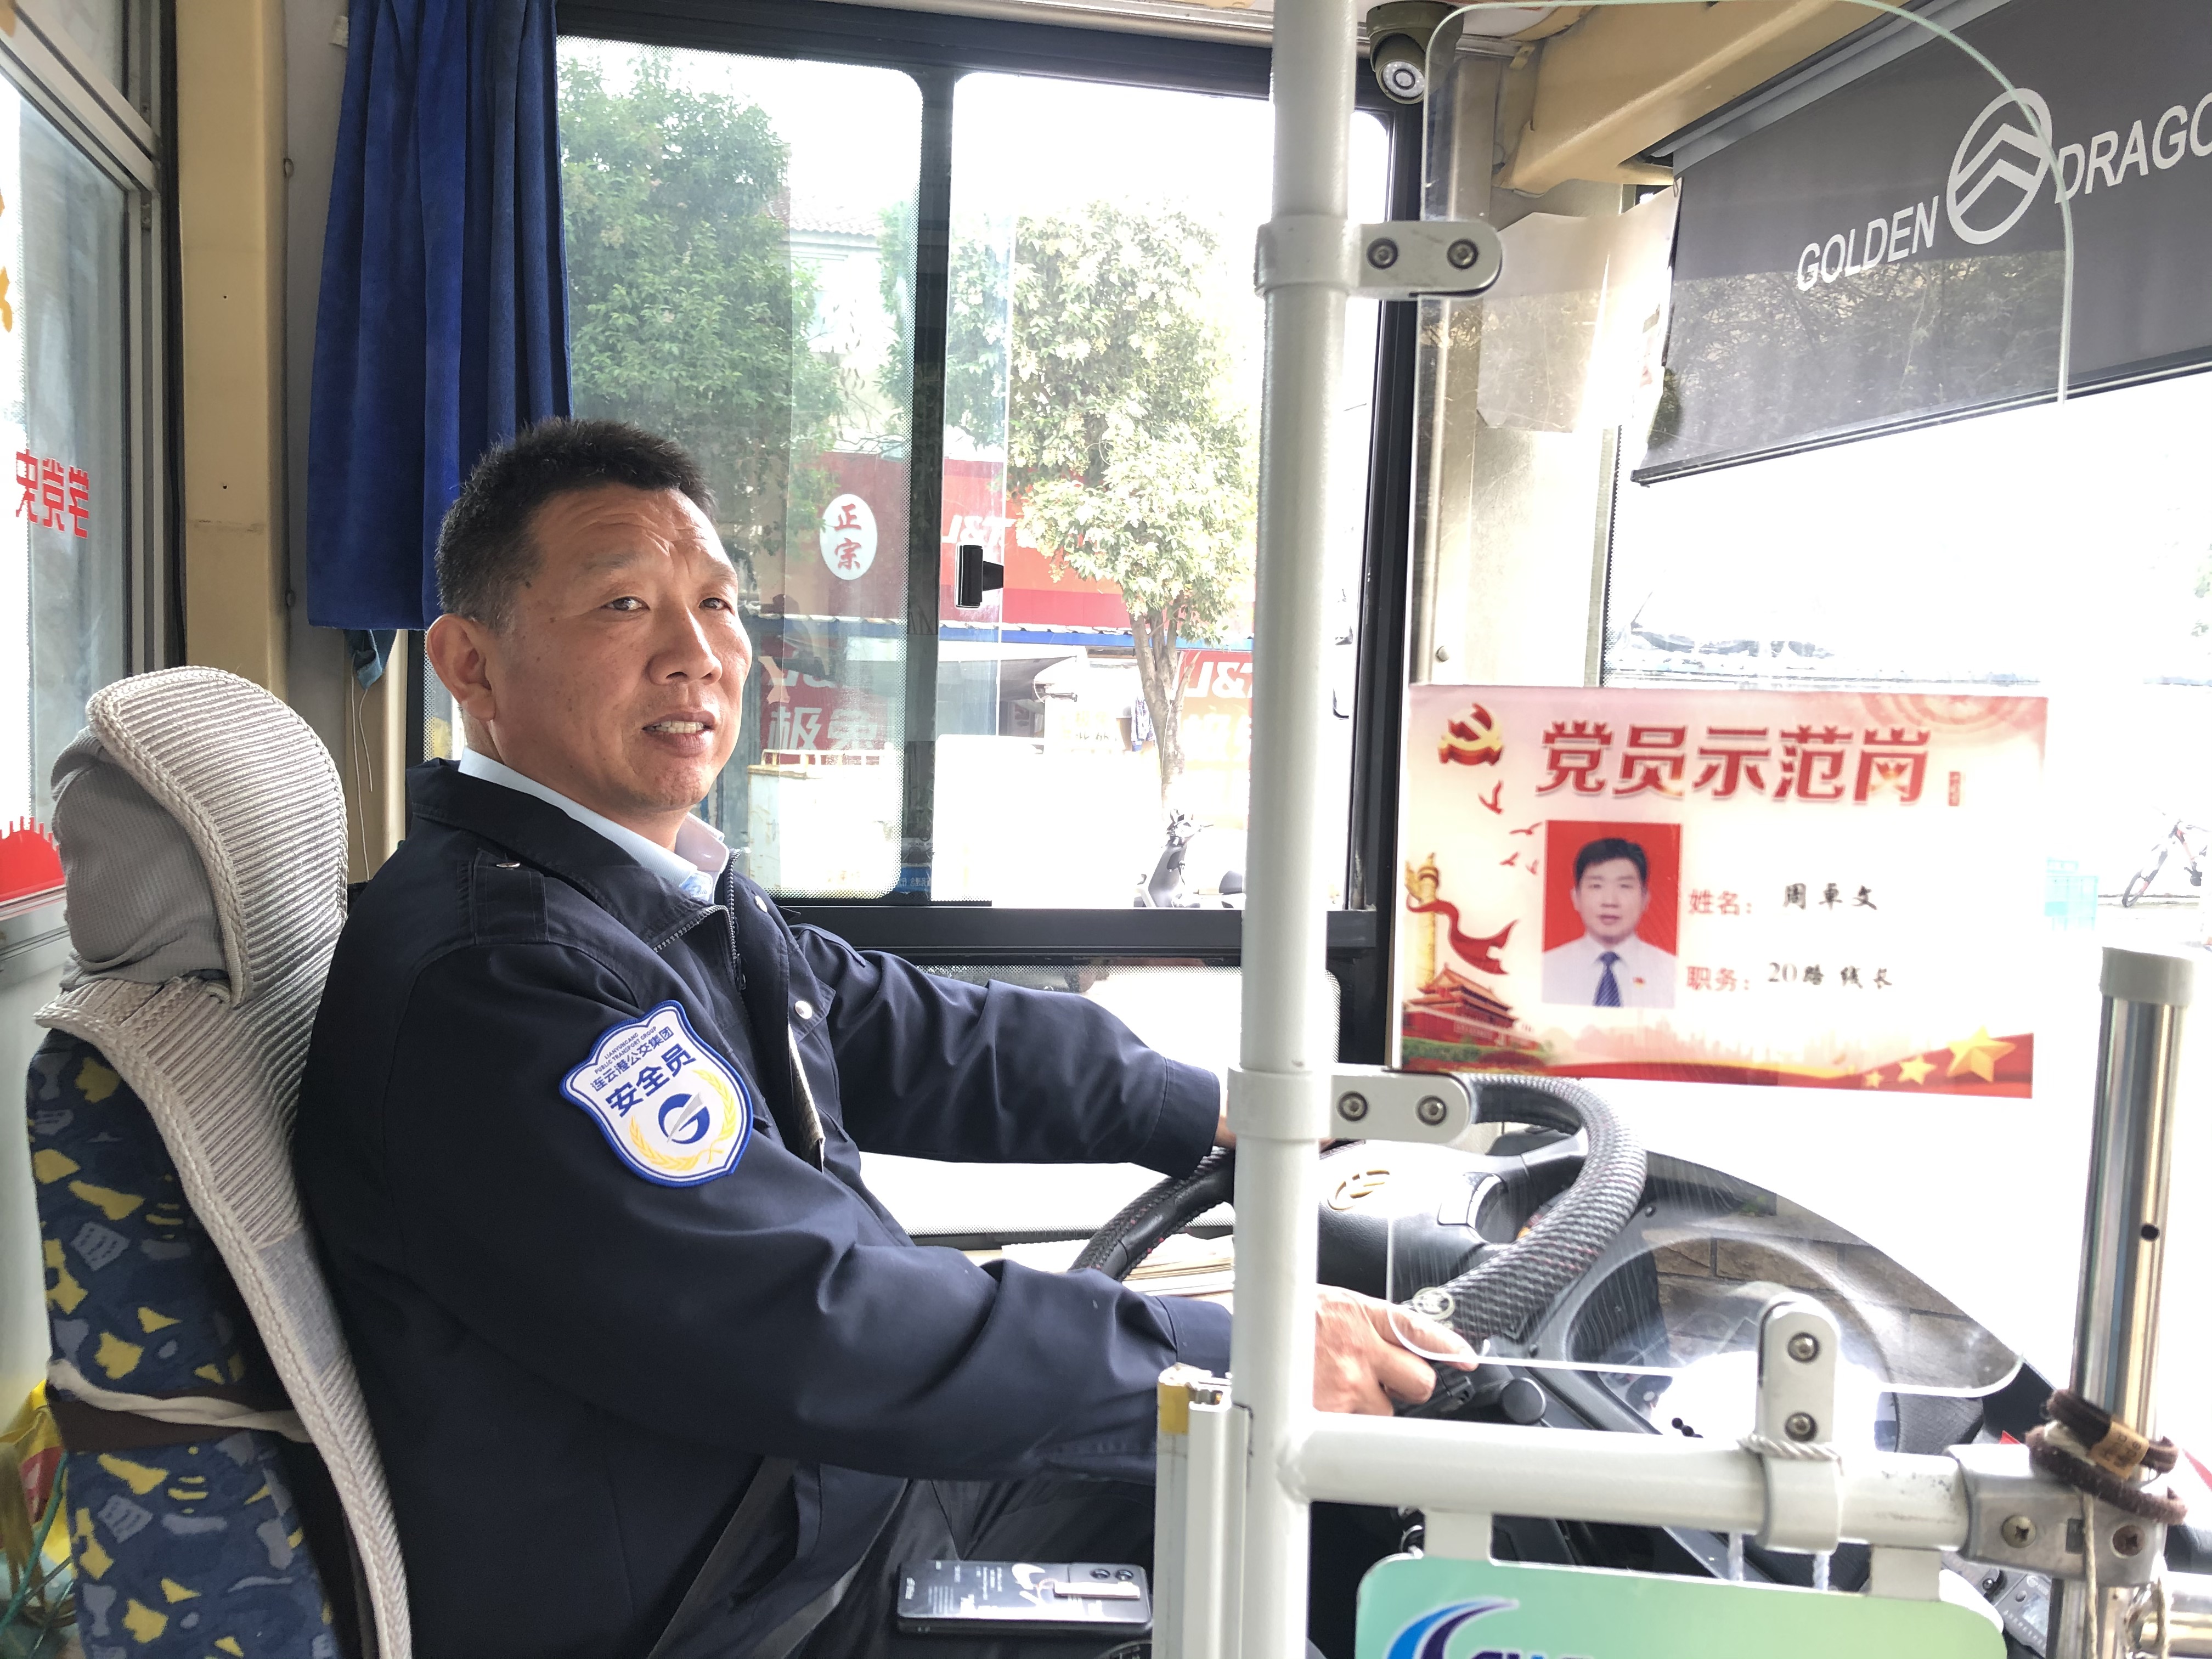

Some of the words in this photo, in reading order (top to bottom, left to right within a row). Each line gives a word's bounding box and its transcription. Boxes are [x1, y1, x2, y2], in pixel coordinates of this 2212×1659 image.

[1797, 195, 1939, 291] GOLDEN
[834, 503, 862, 569] 正宗
[1536, 720, 1931, 805] 党员示范岗
[590, 1026, 674, 1092] 连云港公交集团
[594, 1060, 613, 1074] PUBLIC
[612, 1039, 641, 1061] TRANSPORT
[640, 1026, 657, 1040] GROUP
[605, 1043, 697, 1118] 安全员
